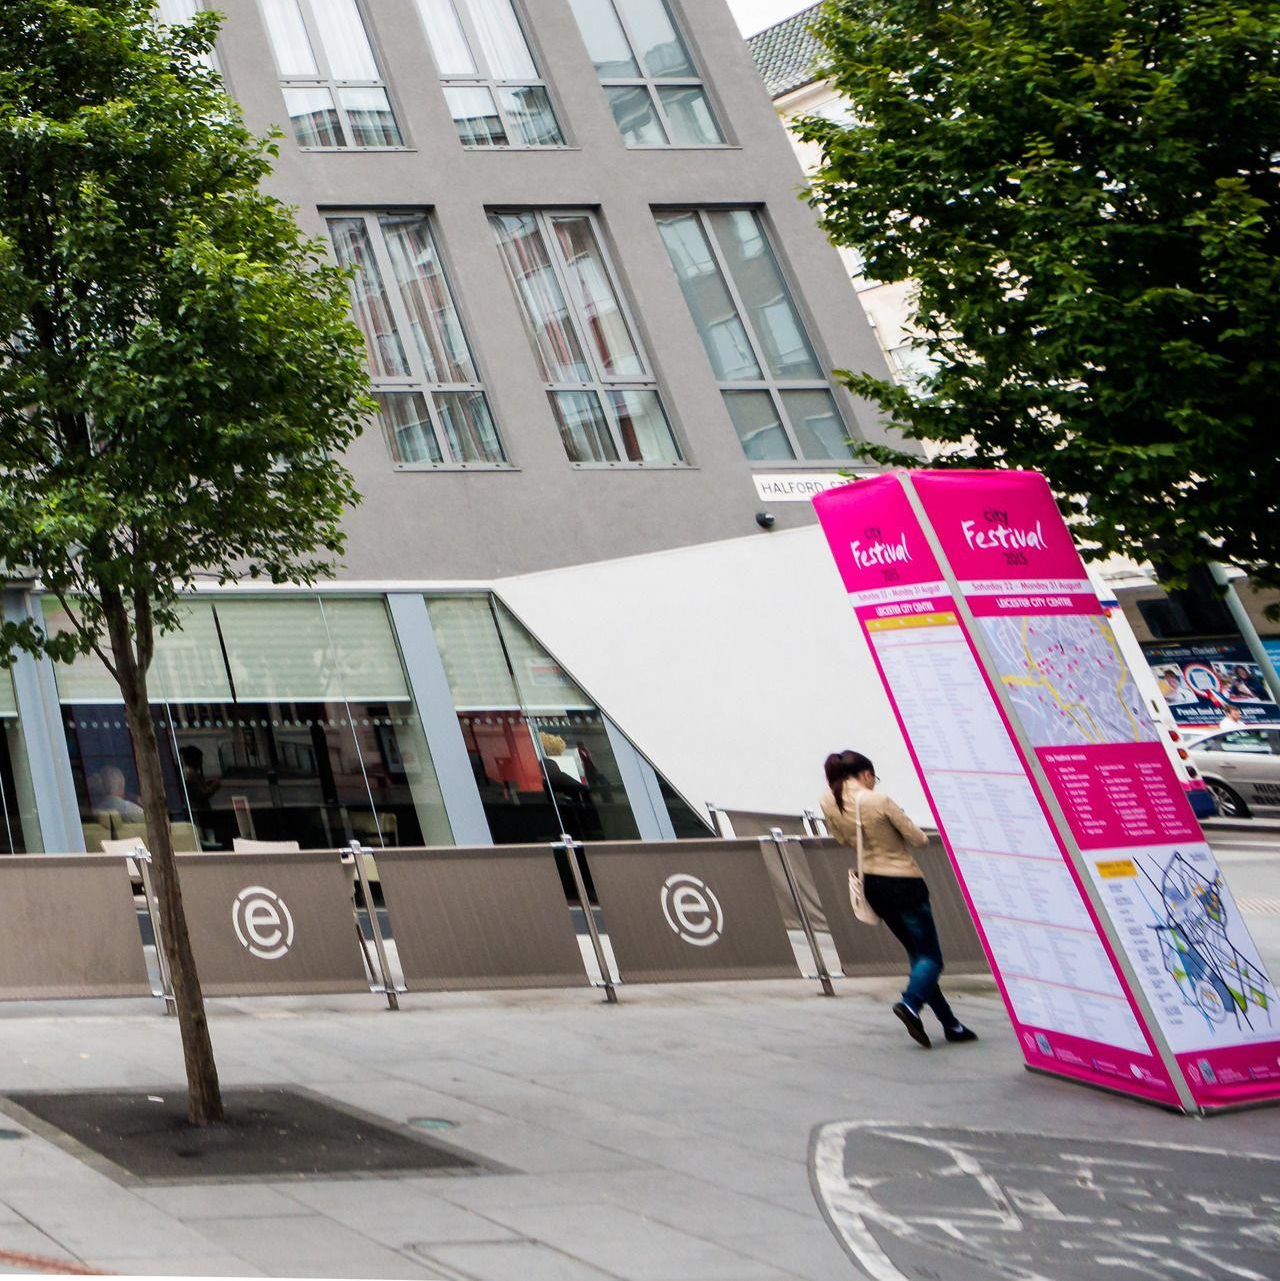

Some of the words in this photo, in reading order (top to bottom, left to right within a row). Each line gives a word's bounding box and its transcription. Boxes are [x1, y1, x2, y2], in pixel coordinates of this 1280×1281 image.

[760, 481, 825, 494] HALFORD
[961, 519, 1048, 551] Festival
[850, 532, 912, 570] Festival
[1003, 551, 1029, 566] 2015
[972, 582, 1003, 592] Saturday
[1020, 581, 1047, 592] Monday
[1059, 581, 1083, 592] August
[1029, 598, 1046, 608] CITY
[1045, 597, 1073, 608] CENTRE
